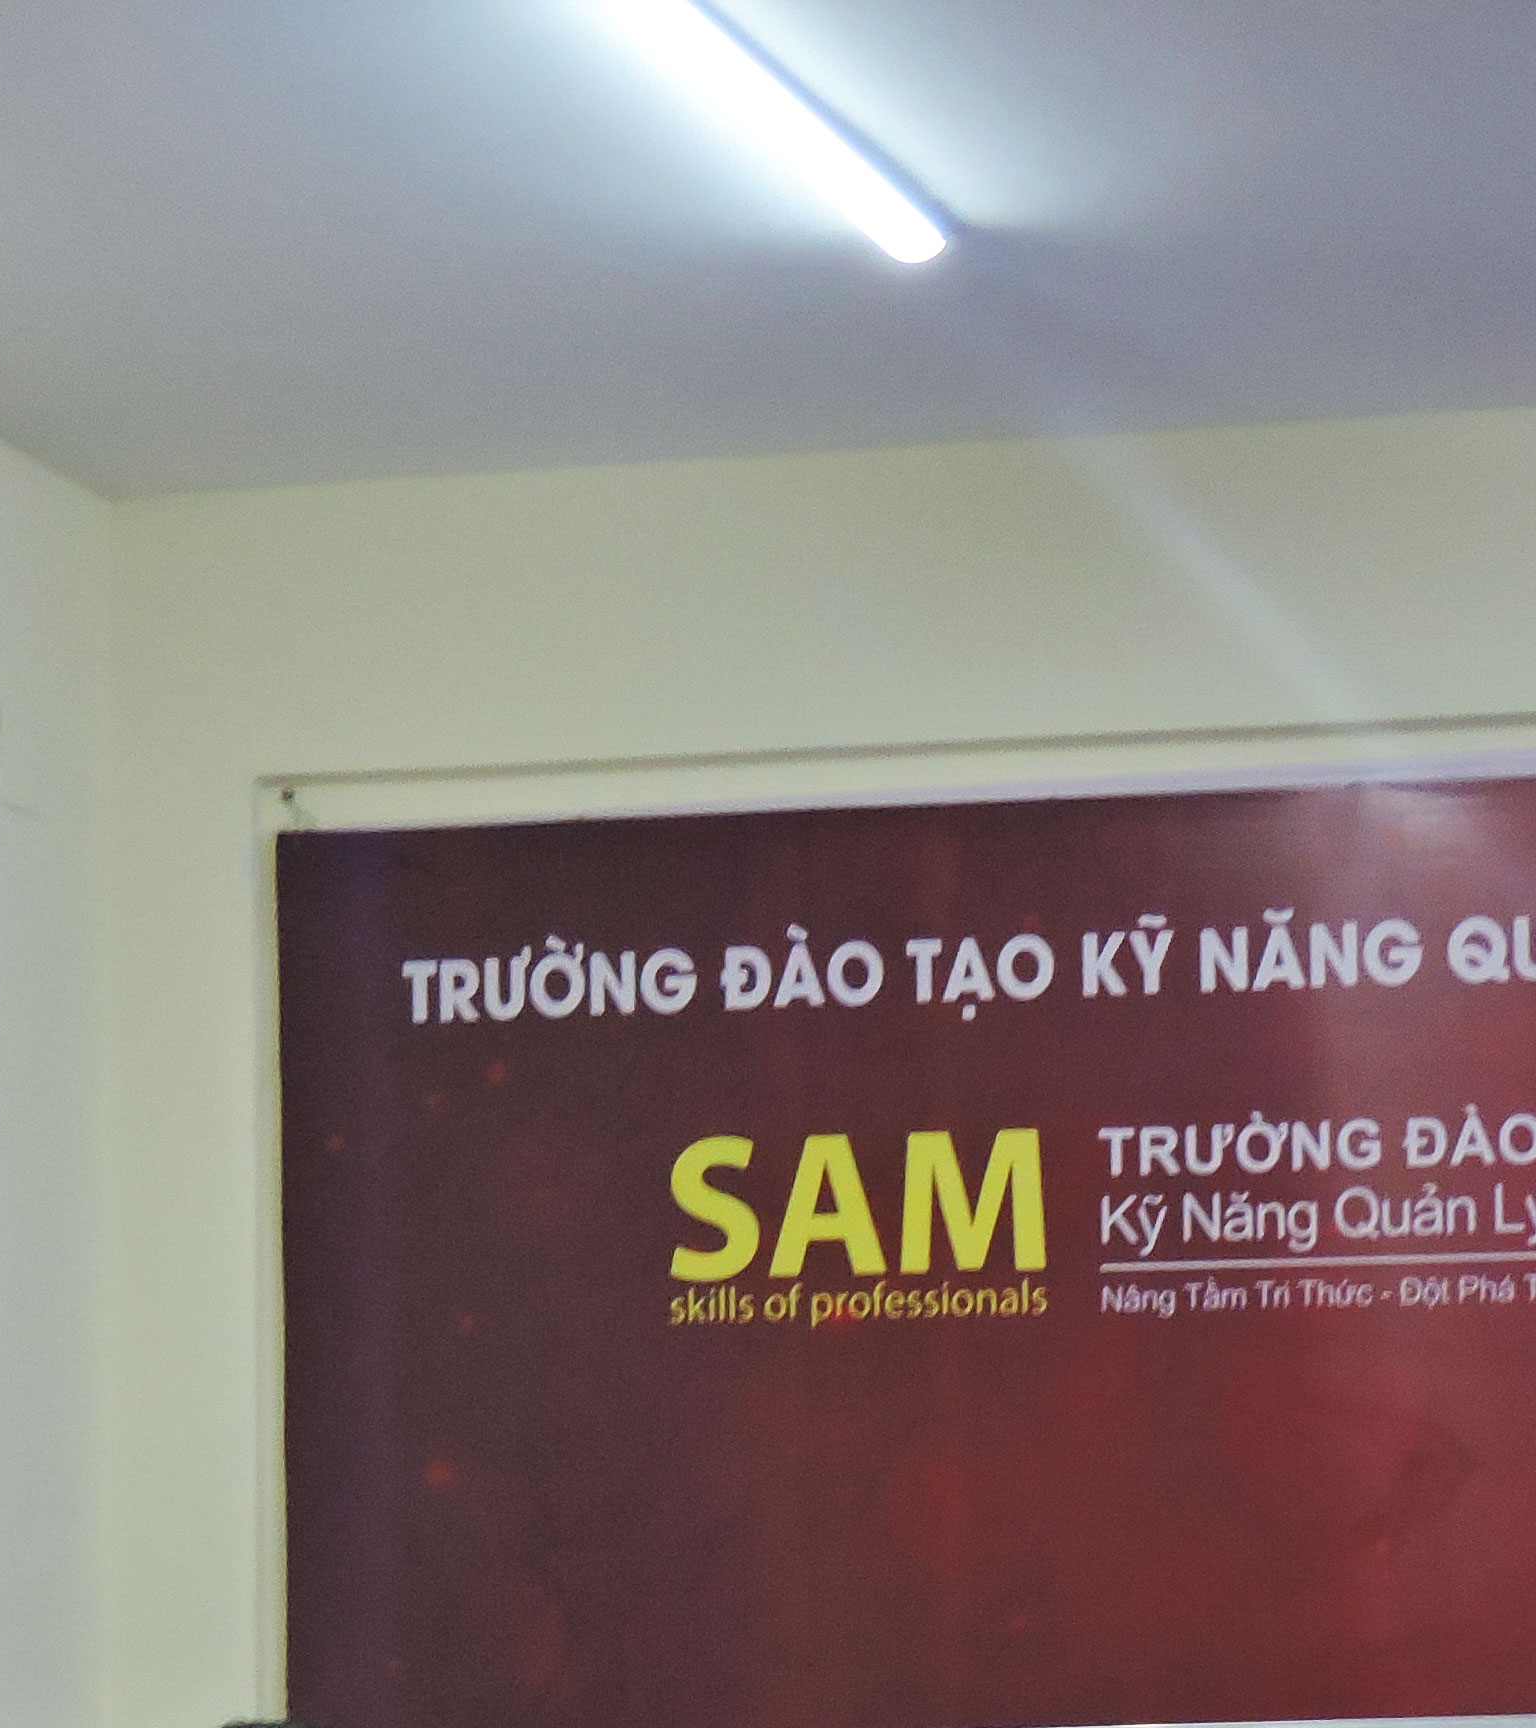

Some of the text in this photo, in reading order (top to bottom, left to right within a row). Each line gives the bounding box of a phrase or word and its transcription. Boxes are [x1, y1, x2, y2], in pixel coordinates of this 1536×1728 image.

[401, 934, 698, 1025] TRƯỜNG
[720, 922, 884, 1012] ĐÀO
[905, 932, 1055, 1021] TẠO
[1081, 913, 1174, 999] KỸ
[1199, 906, 1424, 994] NĂNG
[1098, 1109, 1383, 1179] TRƯỜNG
[669, 1127, 1047, 1282] SAM
[1100, 1193, 1168, 1258] Kỹ
[1182, 1189, 1319, 1253] Năng
[1333, 1181, 1478, 1240] Quản
[669, 1277, 1048, 1329] skills of professionals
[1100, 1283, 1177, 1319] Nâng
